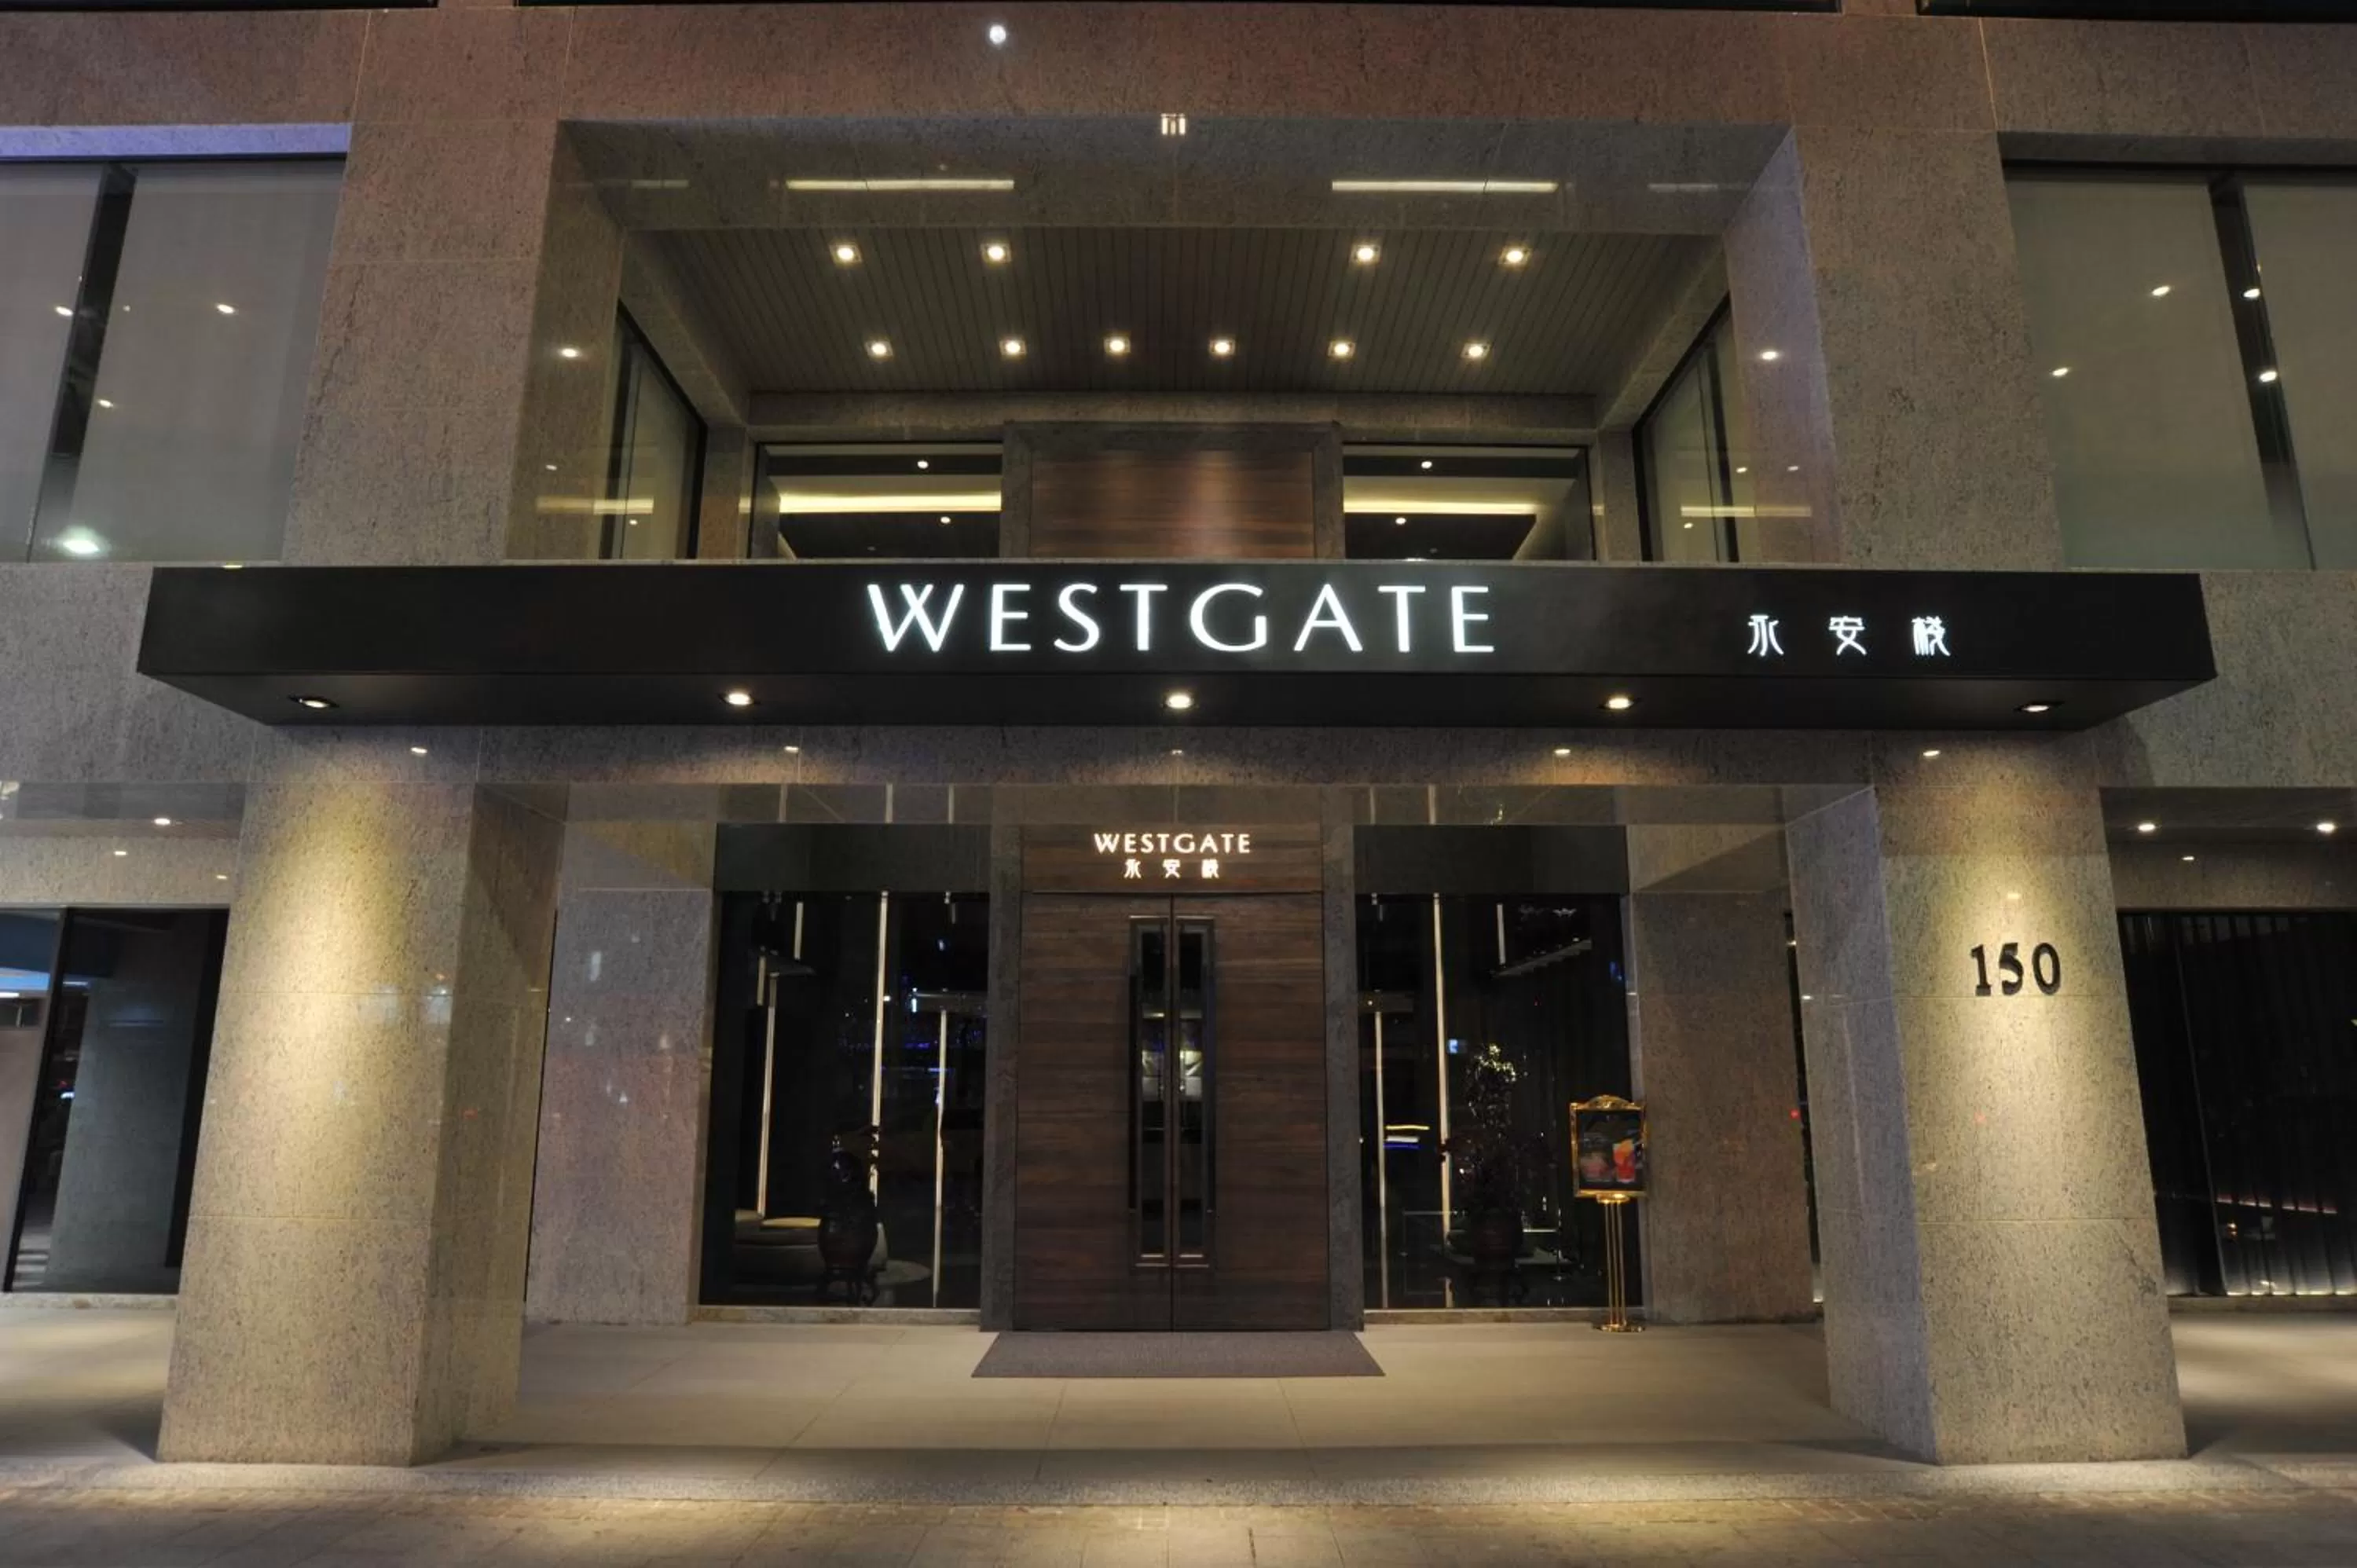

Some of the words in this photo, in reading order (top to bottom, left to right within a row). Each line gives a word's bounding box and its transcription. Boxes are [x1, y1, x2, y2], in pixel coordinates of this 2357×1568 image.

[866, 582, 1494, 654] WESTGATE
[1093, 833, 1251, 854] WESTGATE
[1970, 942, 2062, 996] 150
